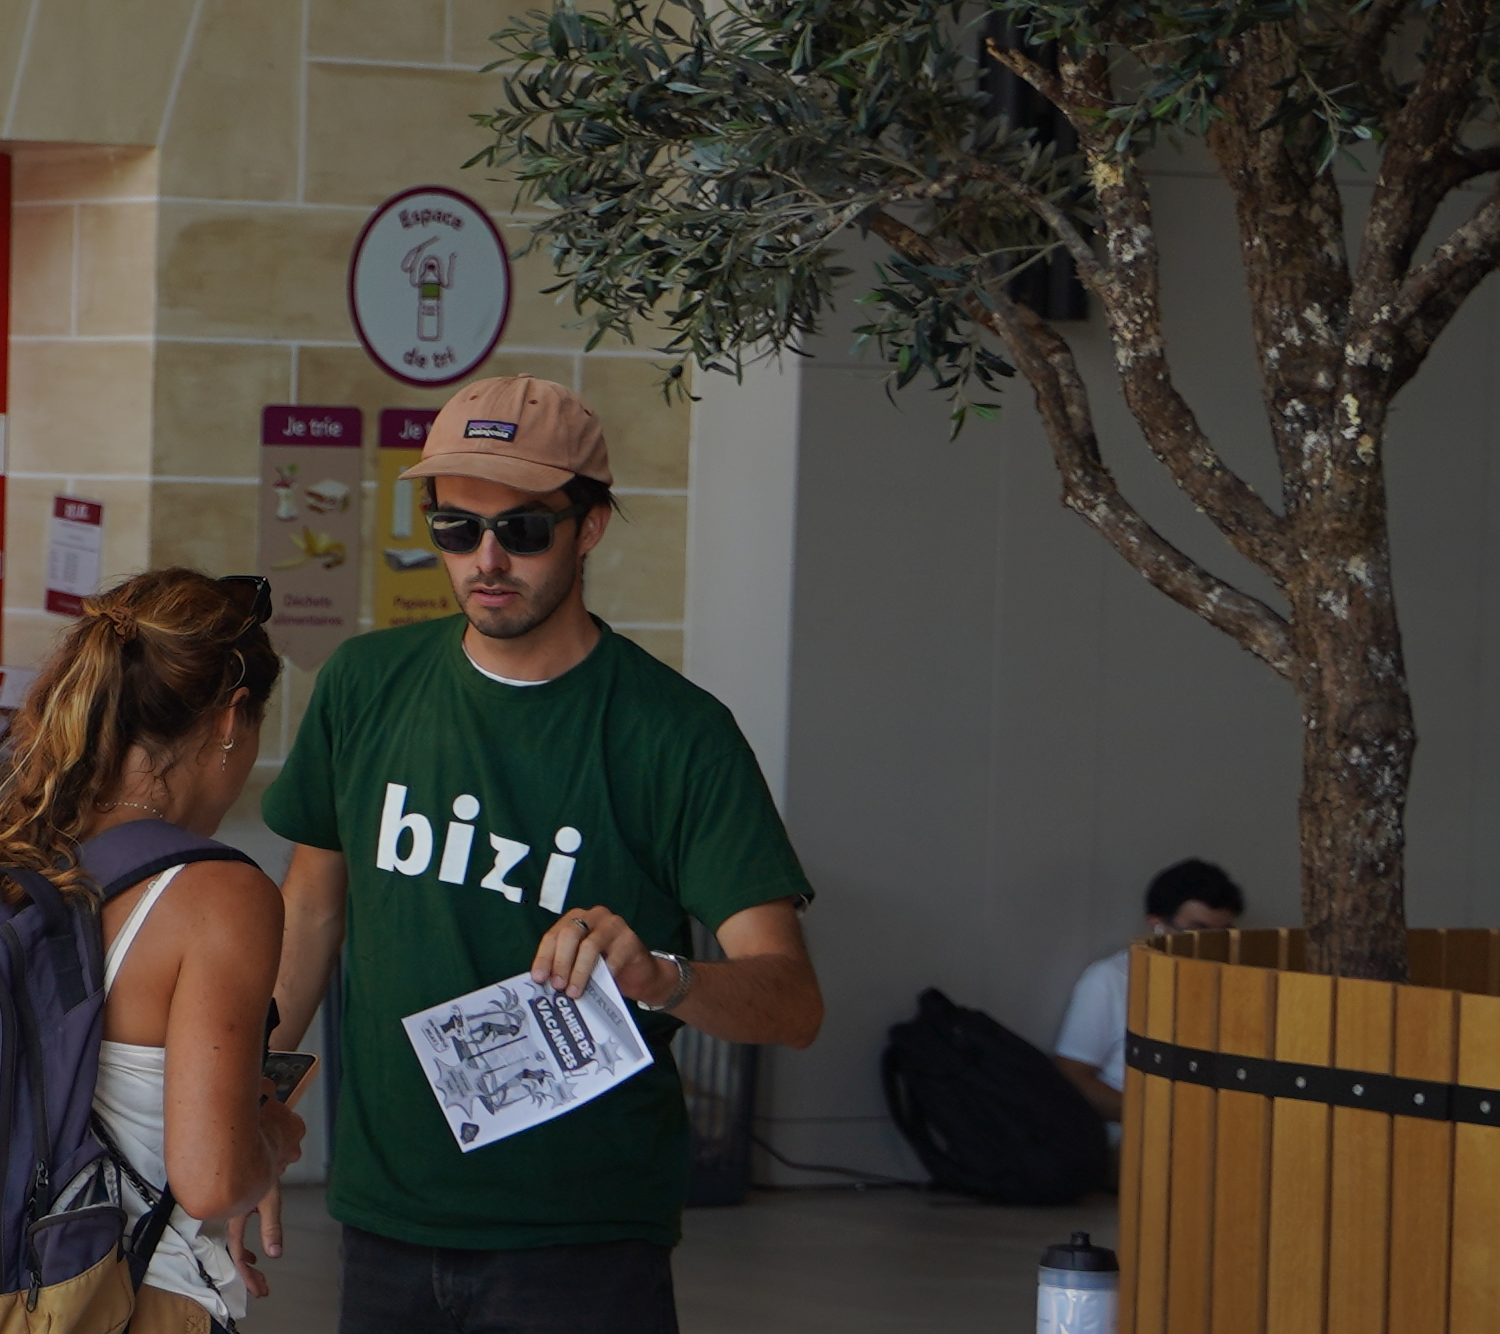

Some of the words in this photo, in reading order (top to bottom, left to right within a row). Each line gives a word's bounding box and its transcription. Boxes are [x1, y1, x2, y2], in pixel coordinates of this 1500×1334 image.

[399, 208, 464, 230] Espace
[403, 348, 426, 369] de
[282, 416, 306, 438] Je
[309, 417, 343, 438] trie
[399, 419, 422, 441] Je
[376, 782, 582, 915] bizi
[553, 994, 585, 1041] CAHIER
[534, 996, 578, 1070] VACANCES
